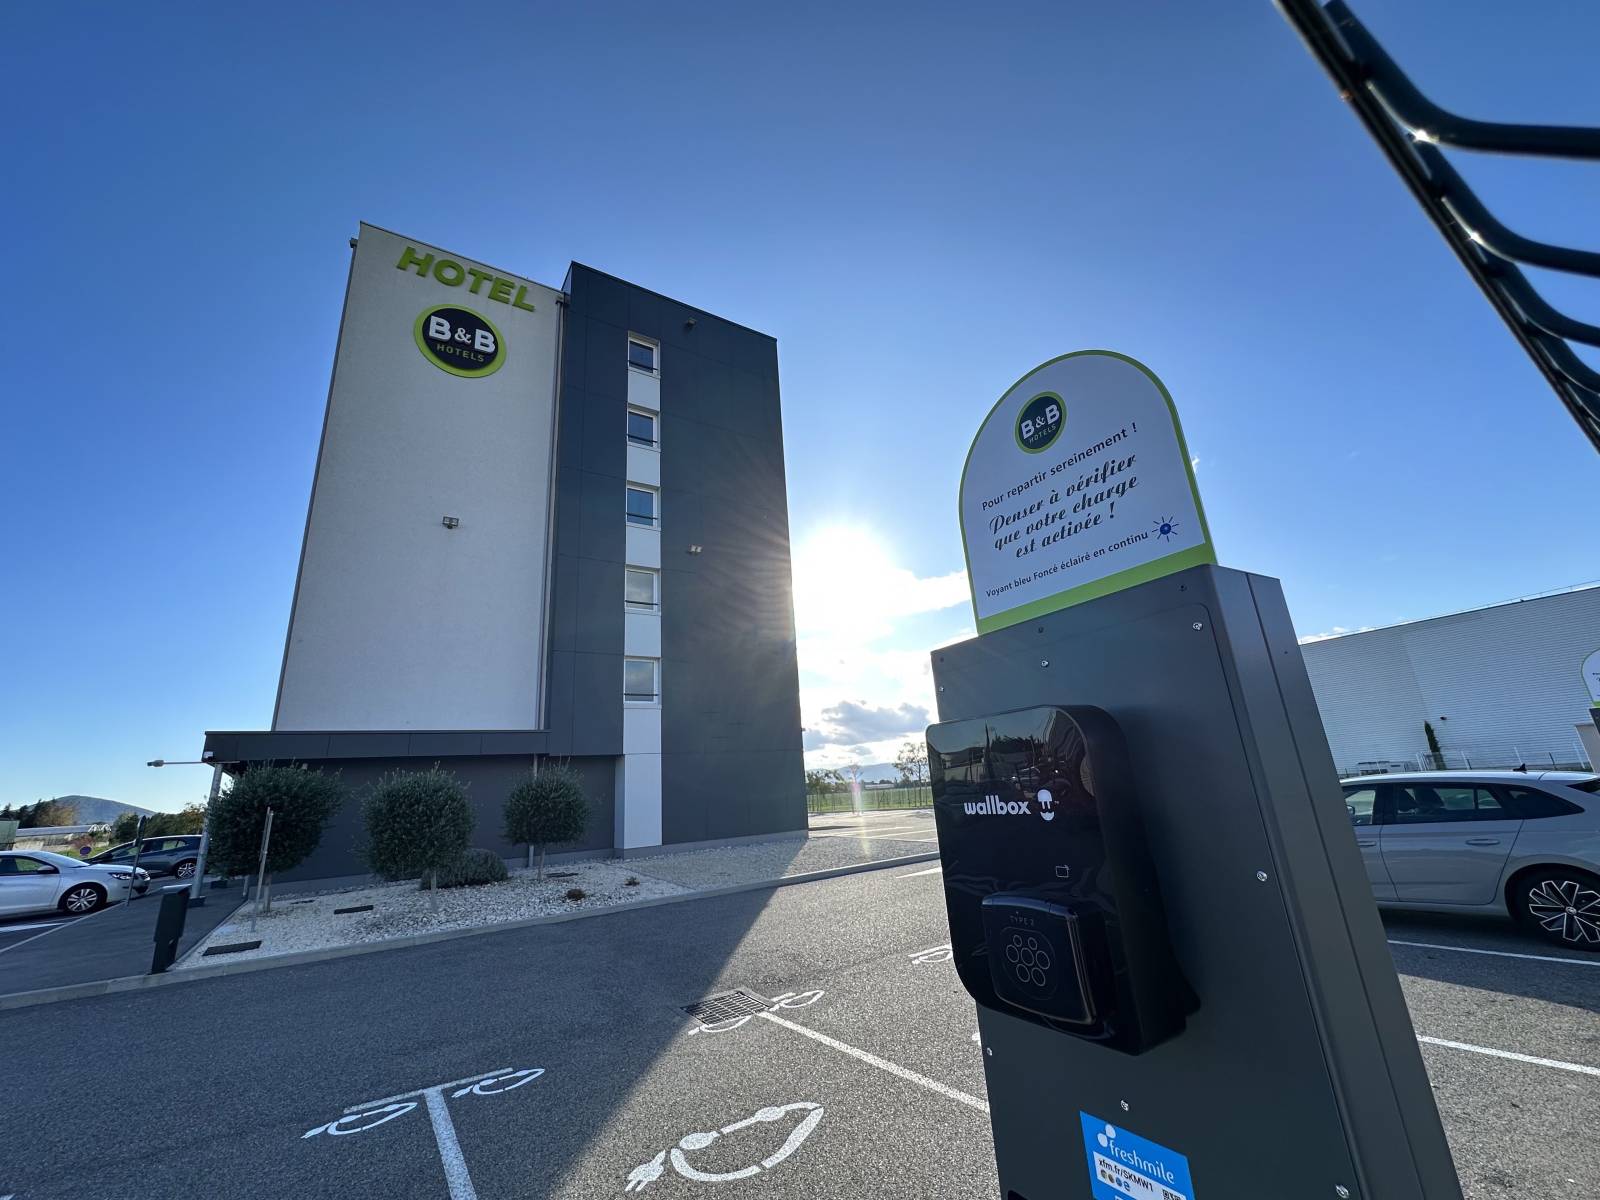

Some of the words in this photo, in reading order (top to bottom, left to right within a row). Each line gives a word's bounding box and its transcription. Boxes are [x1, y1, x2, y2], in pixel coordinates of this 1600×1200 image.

[396, 246, 535, 312] HOTEL
[428, 315, 496, 353] B&B
[436, 343, 484, 362] HOTELS
[1021, 404, 1060, 440] B&B
[1029, 424, 1056, 444] HOTELS
[982, 494, 1004, 511] Pour
[1007, 472, 1046, 498] repartir
[1050, 428, 1128, 476] sereinement
[1132, 422, 1137, 433] !
[989, 500, 1044, 535] Penser
[1049, 489, 1060, 504] à
[1066, 455, 1136, 496] vérifier
[995, 530, 1020, 551] que
[1026, 509, 1066, 535] votre
[1073, 476, 1138, 513] charge
[1016, 538, 1036, 558] est
[1042, 512, 1102, 547] activée
[1109, 501, 1115, 519] !
[986, 583, 1013, 597] Voyant
[1014, 576, 1031, 588] bleu
[1033, 565, 1058, 580] Foncé
[1060, 552, 1091, 570] éclairé
[1093, 548, 1105, 558] en
[1108, 532, 1149, 552] continu
[964, 795, 1032, 815] wallbox
[1109, 1140, 1175, 1185] freshmile
